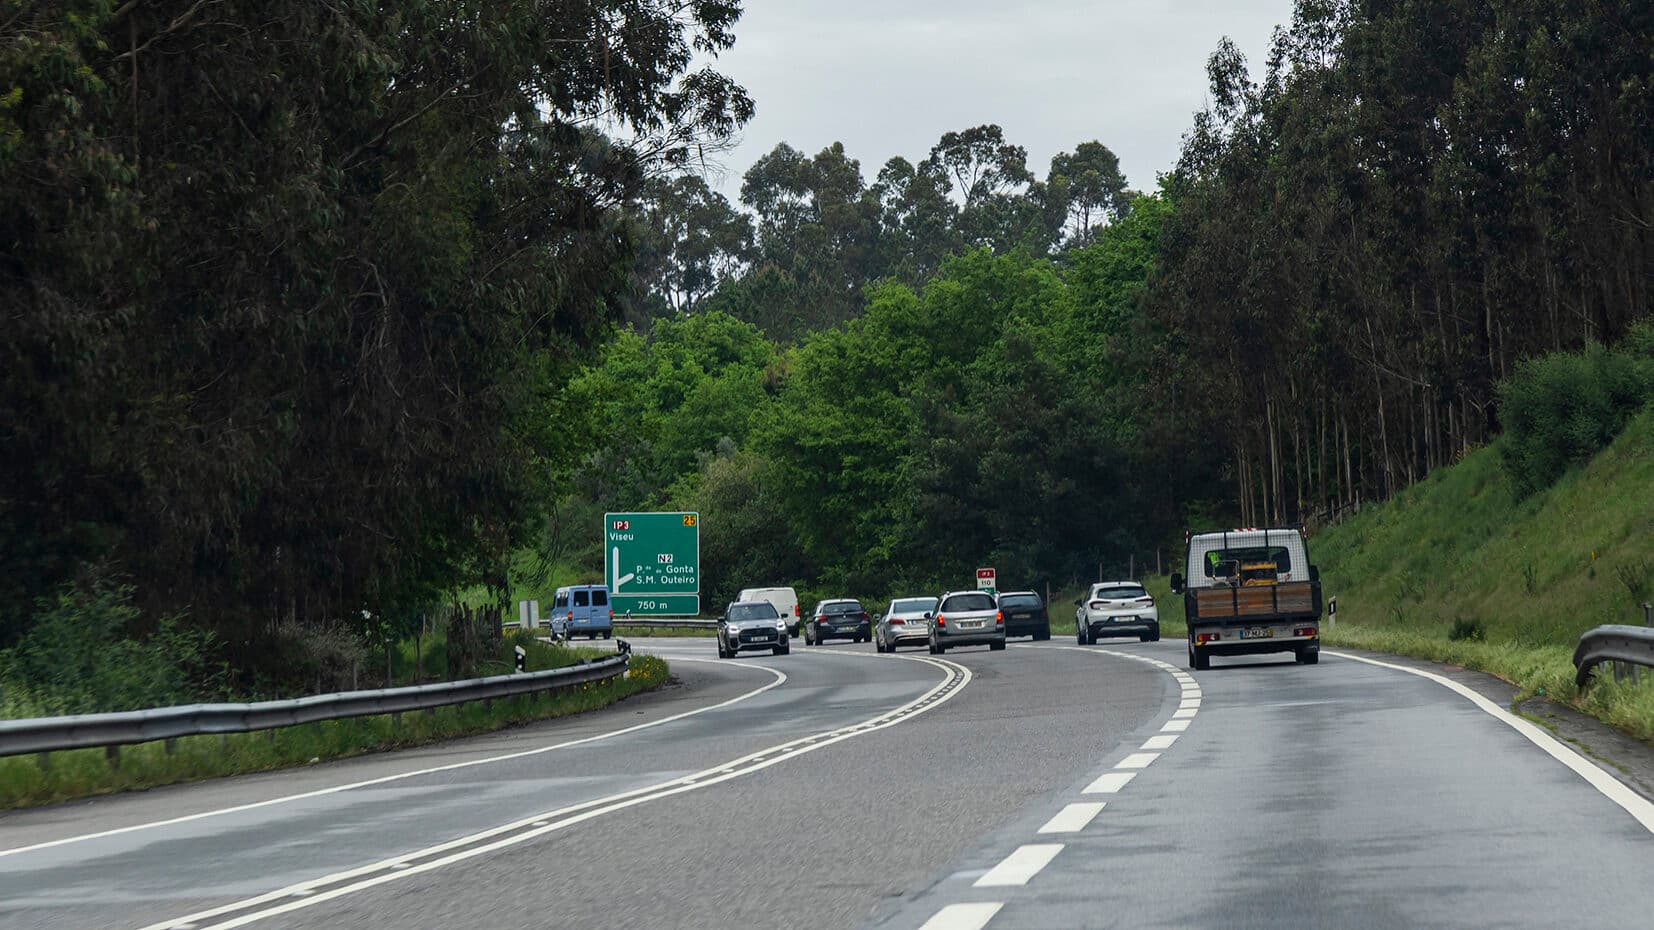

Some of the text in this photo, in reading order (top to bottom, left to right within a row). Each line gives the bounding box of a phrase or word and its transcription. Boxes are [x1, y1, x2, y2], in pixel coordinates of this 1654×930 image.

[683, 516, 696, 525] 25
[609, 532, 634, 541] Viseu
[658, 555, 673, 563] N2
[666, 565, 694, 574] Gonta
[636, 575, 695, 585] S.M. Outeiro
[638, 600, 656, 610] 750
